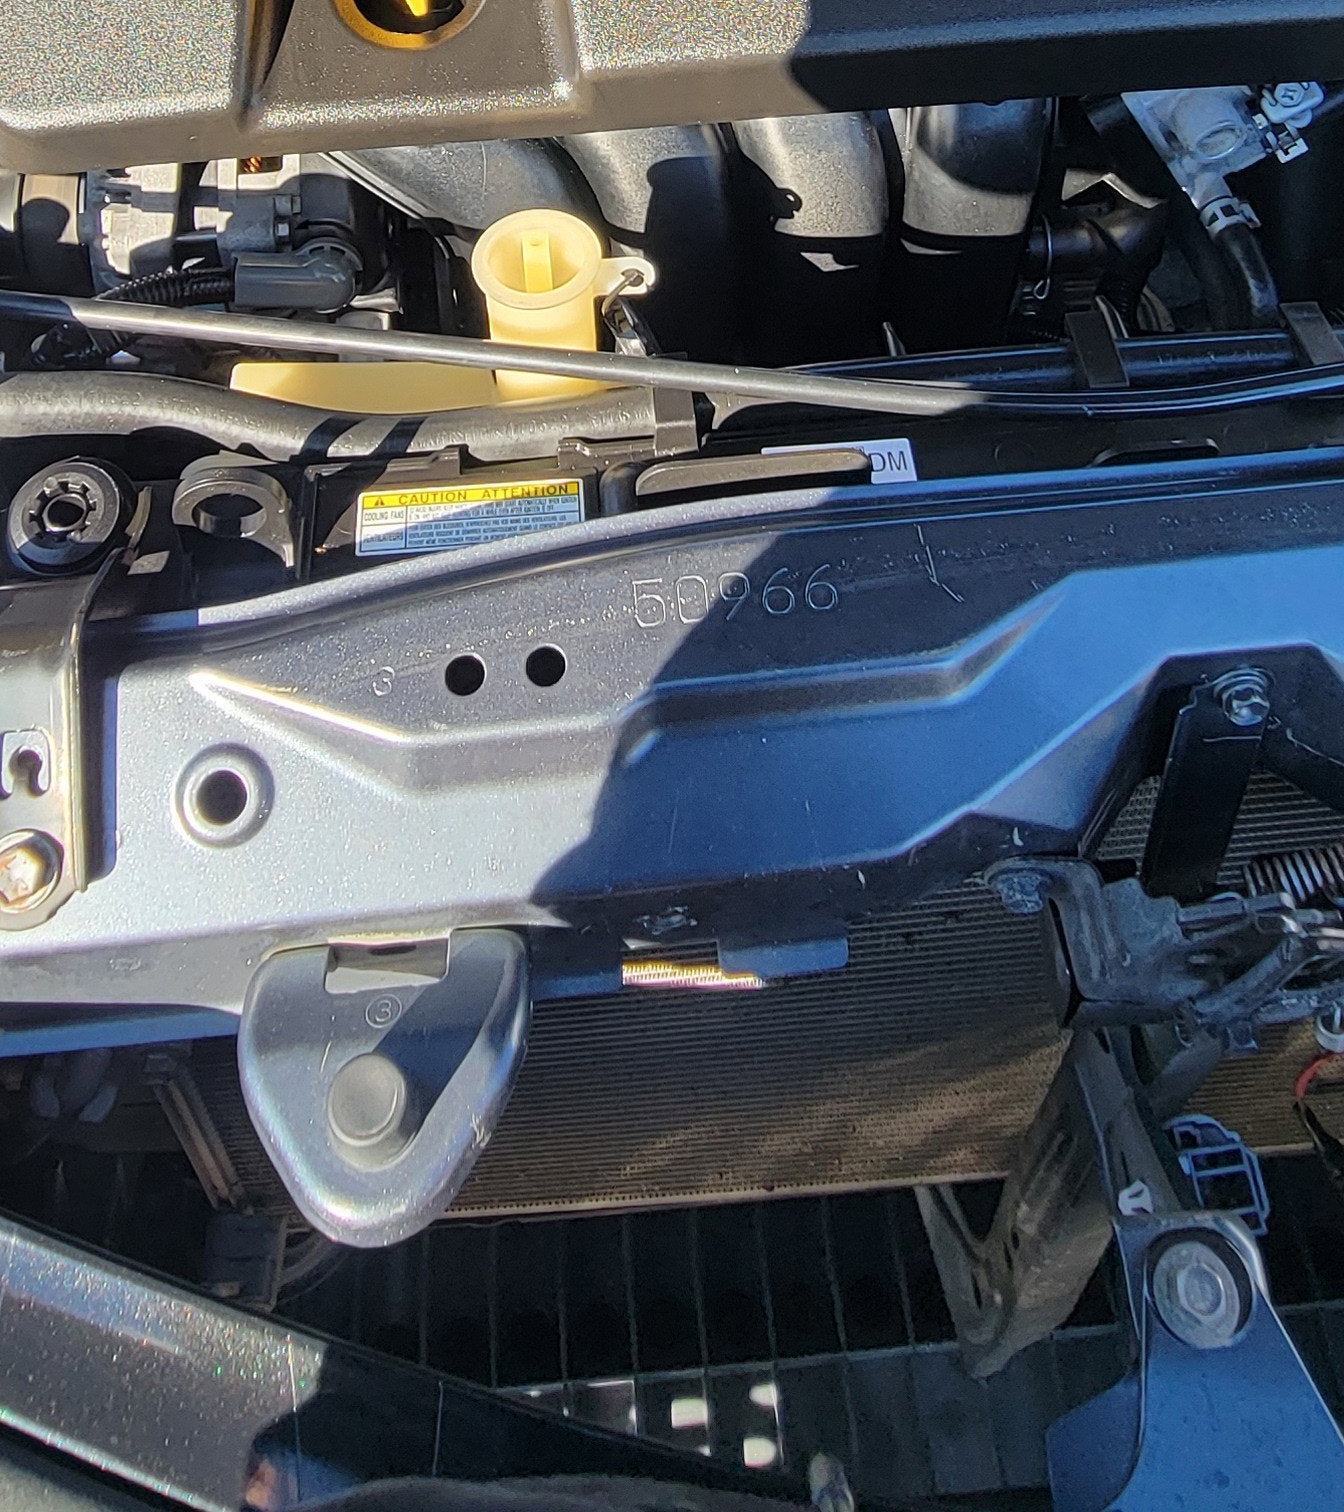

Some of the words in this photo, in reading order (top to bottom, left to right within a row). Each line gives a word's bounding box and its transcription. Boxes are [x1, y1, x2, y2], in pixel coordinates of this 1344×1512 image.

[868, 450, 908, 473] DM
[398, 491, 467, 506] CAUTION
[482, 484, 569, 499] ATTENTION
[631, 564, 839, 628] 50966
